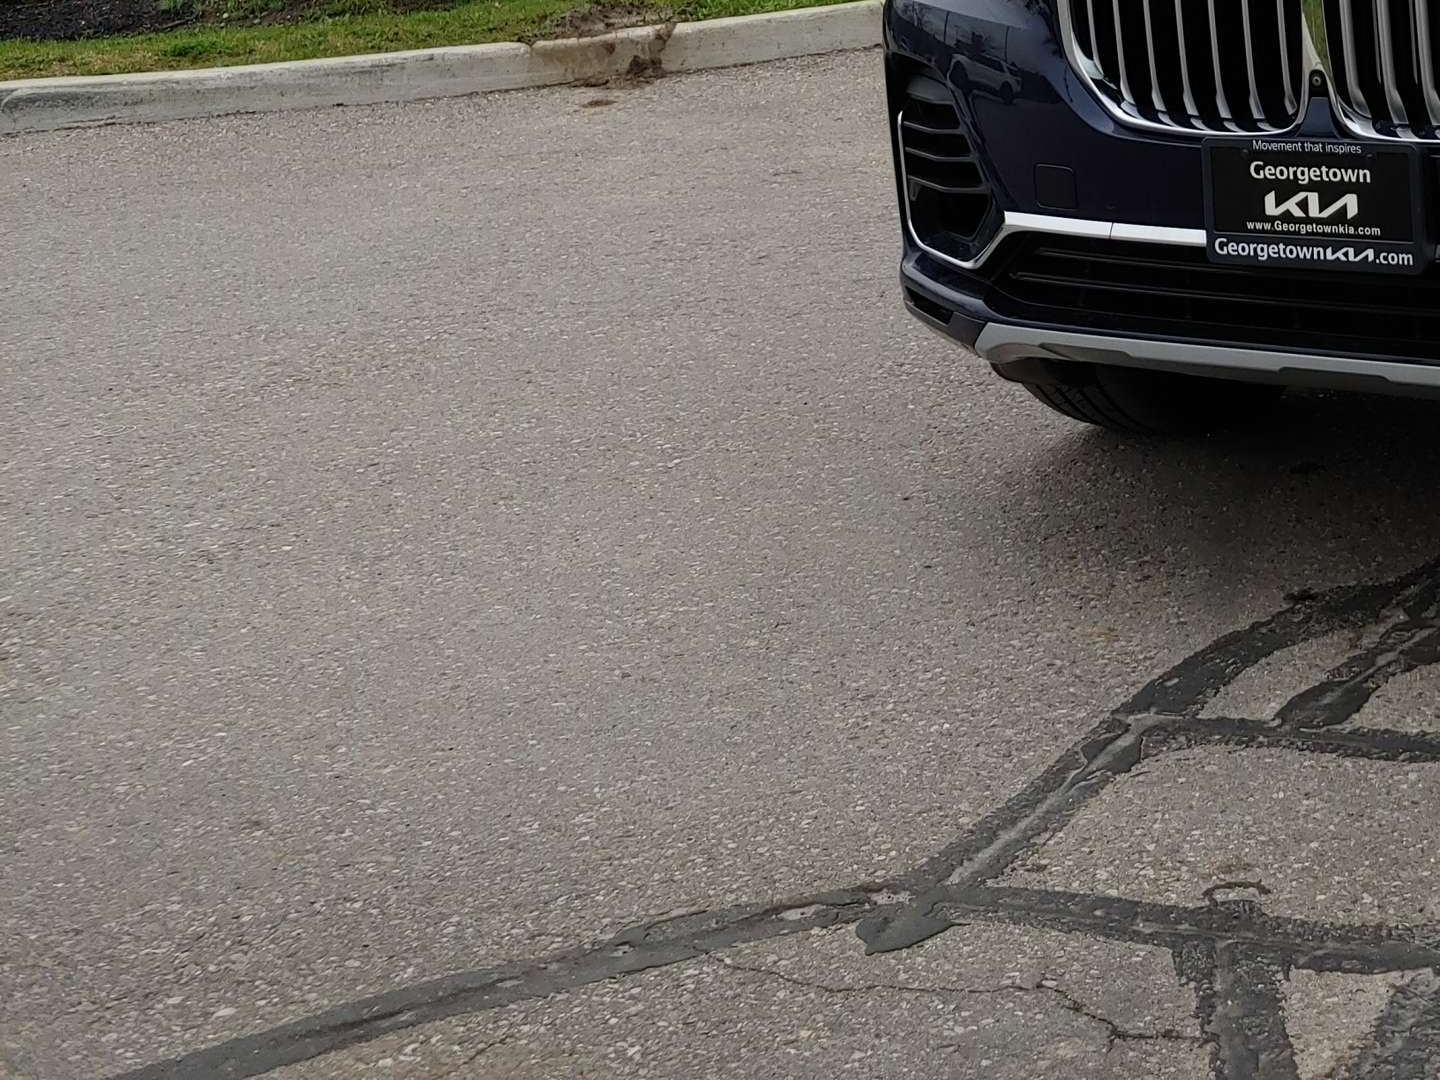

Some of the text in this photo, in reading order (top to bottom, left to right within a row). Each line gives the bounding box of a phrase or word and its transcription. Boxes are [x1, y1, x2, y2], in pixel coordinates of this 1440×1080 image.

[1252, 139, 1361, 155] Movement that inspires
[1250, 161, 1371, 184] Georgetown
[1264, 190, 1358, 220] KIA
[1246, 220, 1381, 236] www.Georgetownkia.com
